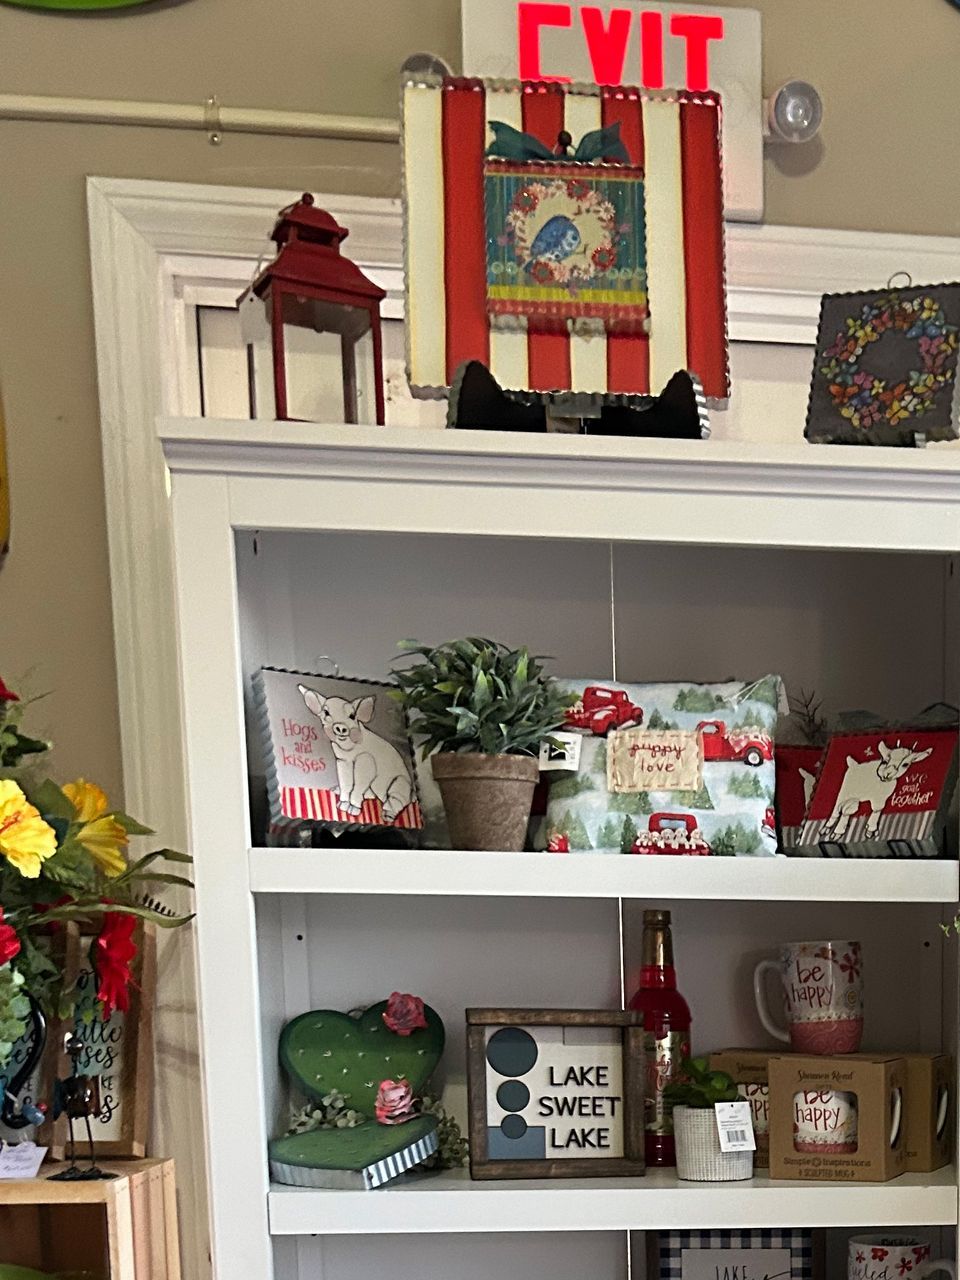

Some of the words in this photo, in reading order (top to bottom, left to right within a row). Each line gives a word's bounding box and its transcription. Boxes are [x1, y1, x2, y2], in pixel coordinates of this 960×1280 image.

[281, 718, 319, 741] Hogs
[294, 741, 313, 753] and
[628, 742, 685, 758] puppy
[280, 746, 327, 773] kisses
[640, 762, 675, 773] love
[891, 791, 934, 807] together
[796, 959, 825, 984] be
[791, 983, 835, 1008] happy
[549, 1065, 609, 1087] LAKE
[538, 1096, 622, 1117] SWEET
[795, 1102, 841, 1131] happy
[551, 1127, 611, 1149] LAKE
